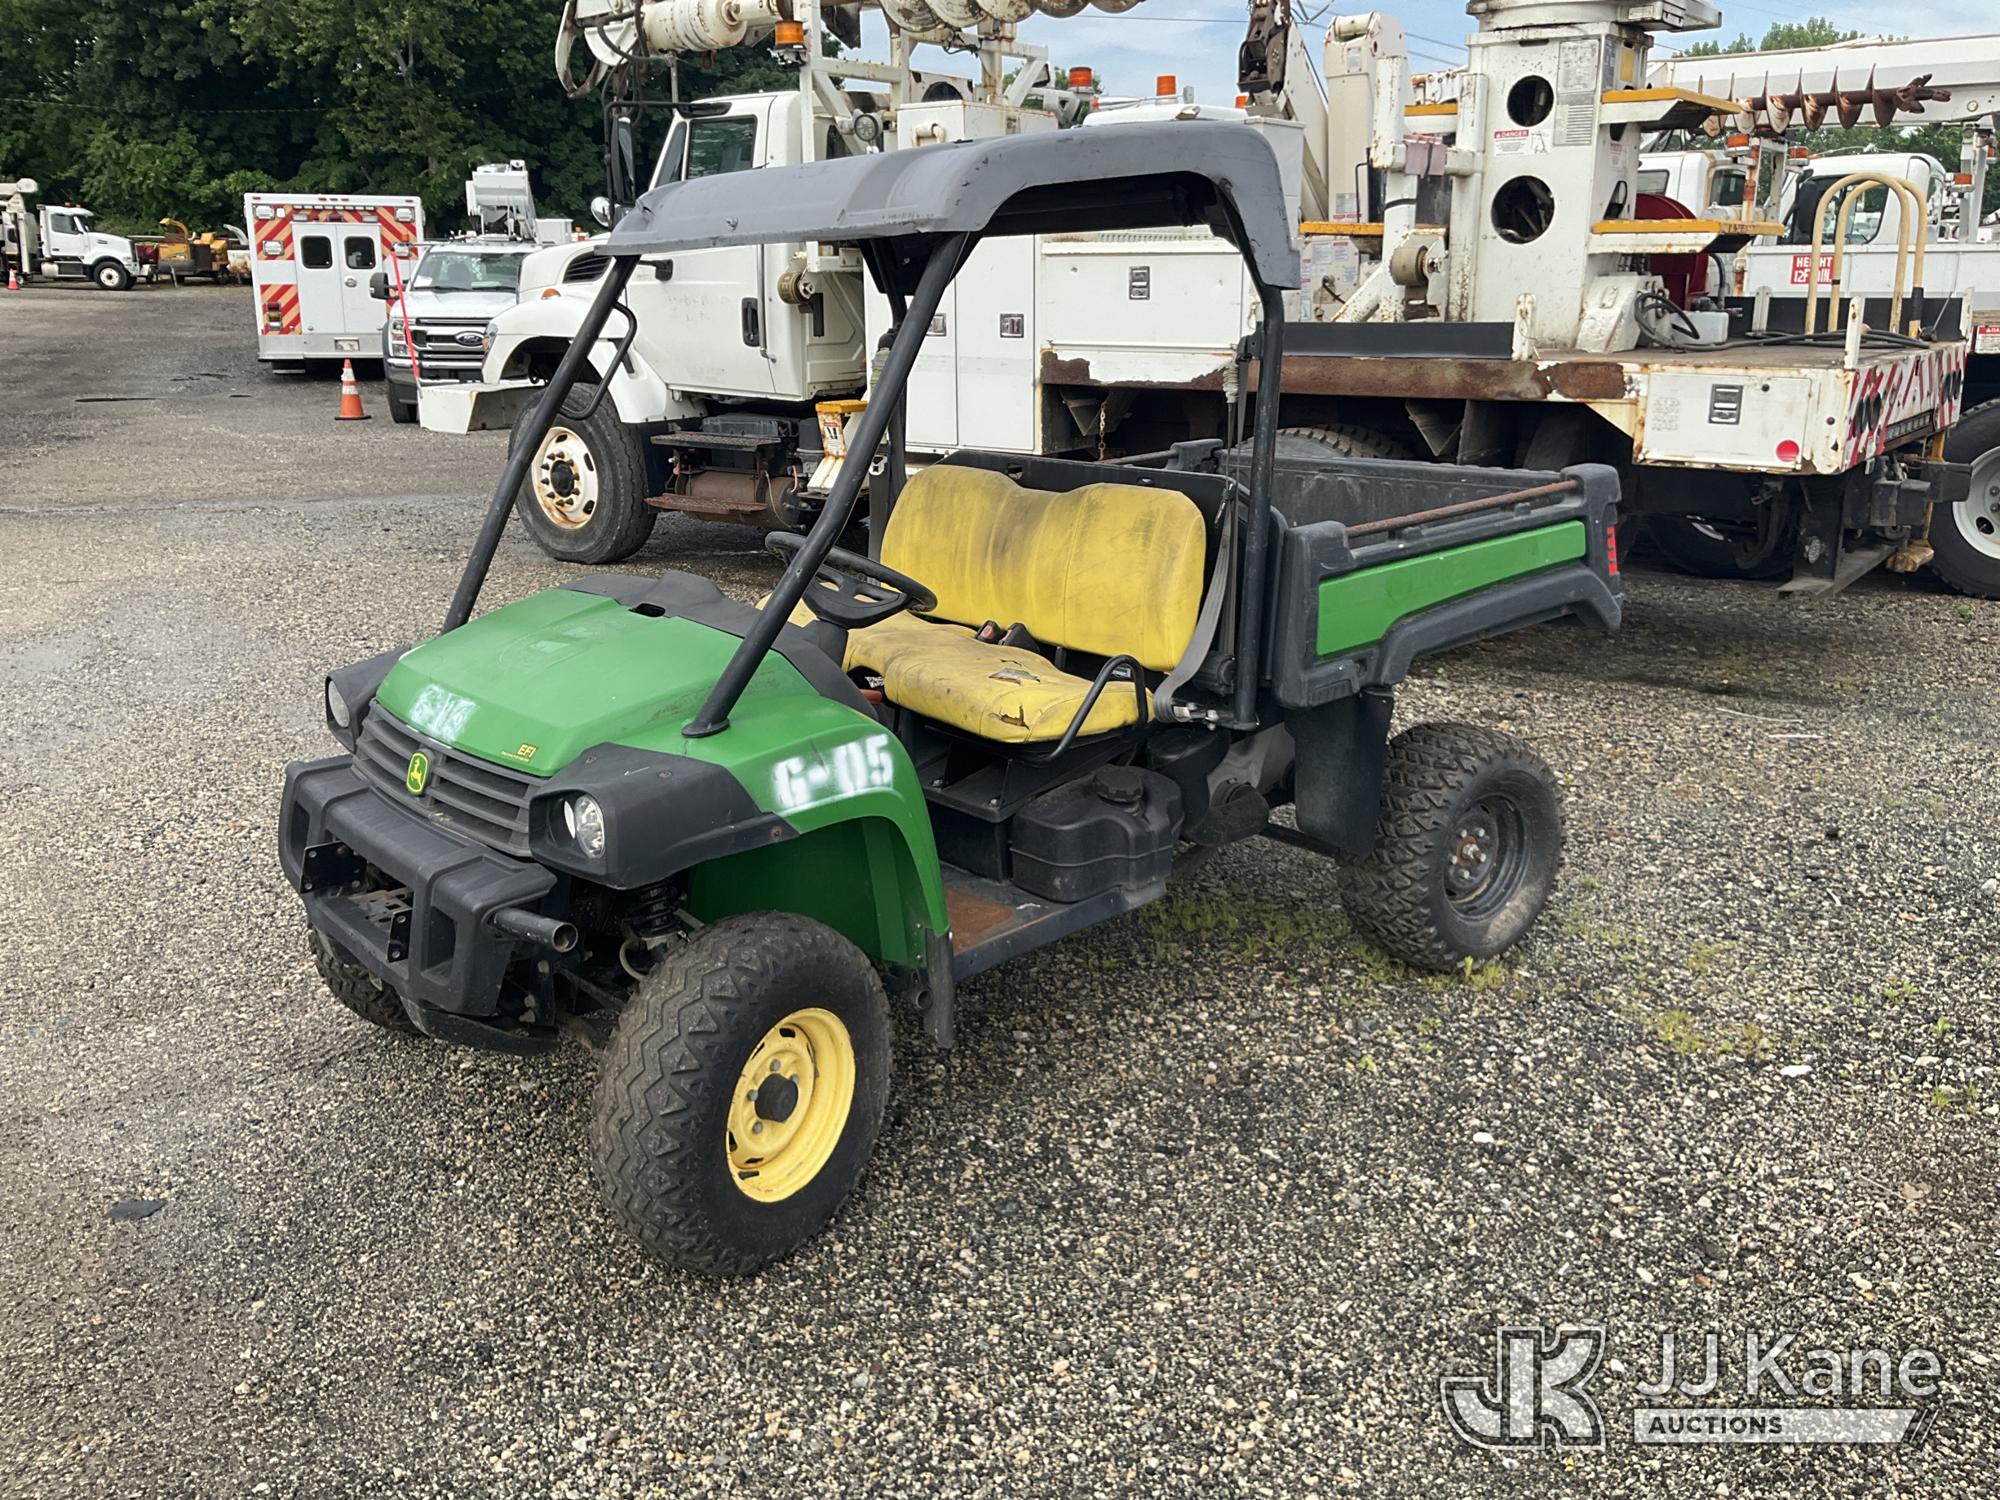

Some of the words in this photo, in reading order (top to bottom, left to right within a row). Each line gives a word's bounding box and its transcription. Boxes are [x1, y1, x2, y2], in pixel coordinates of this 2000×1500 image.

[1796, 256, 1833, 267] HEHT
[517, 743, 537, 758] EFI
[773, 733, 893, 806] G-05
